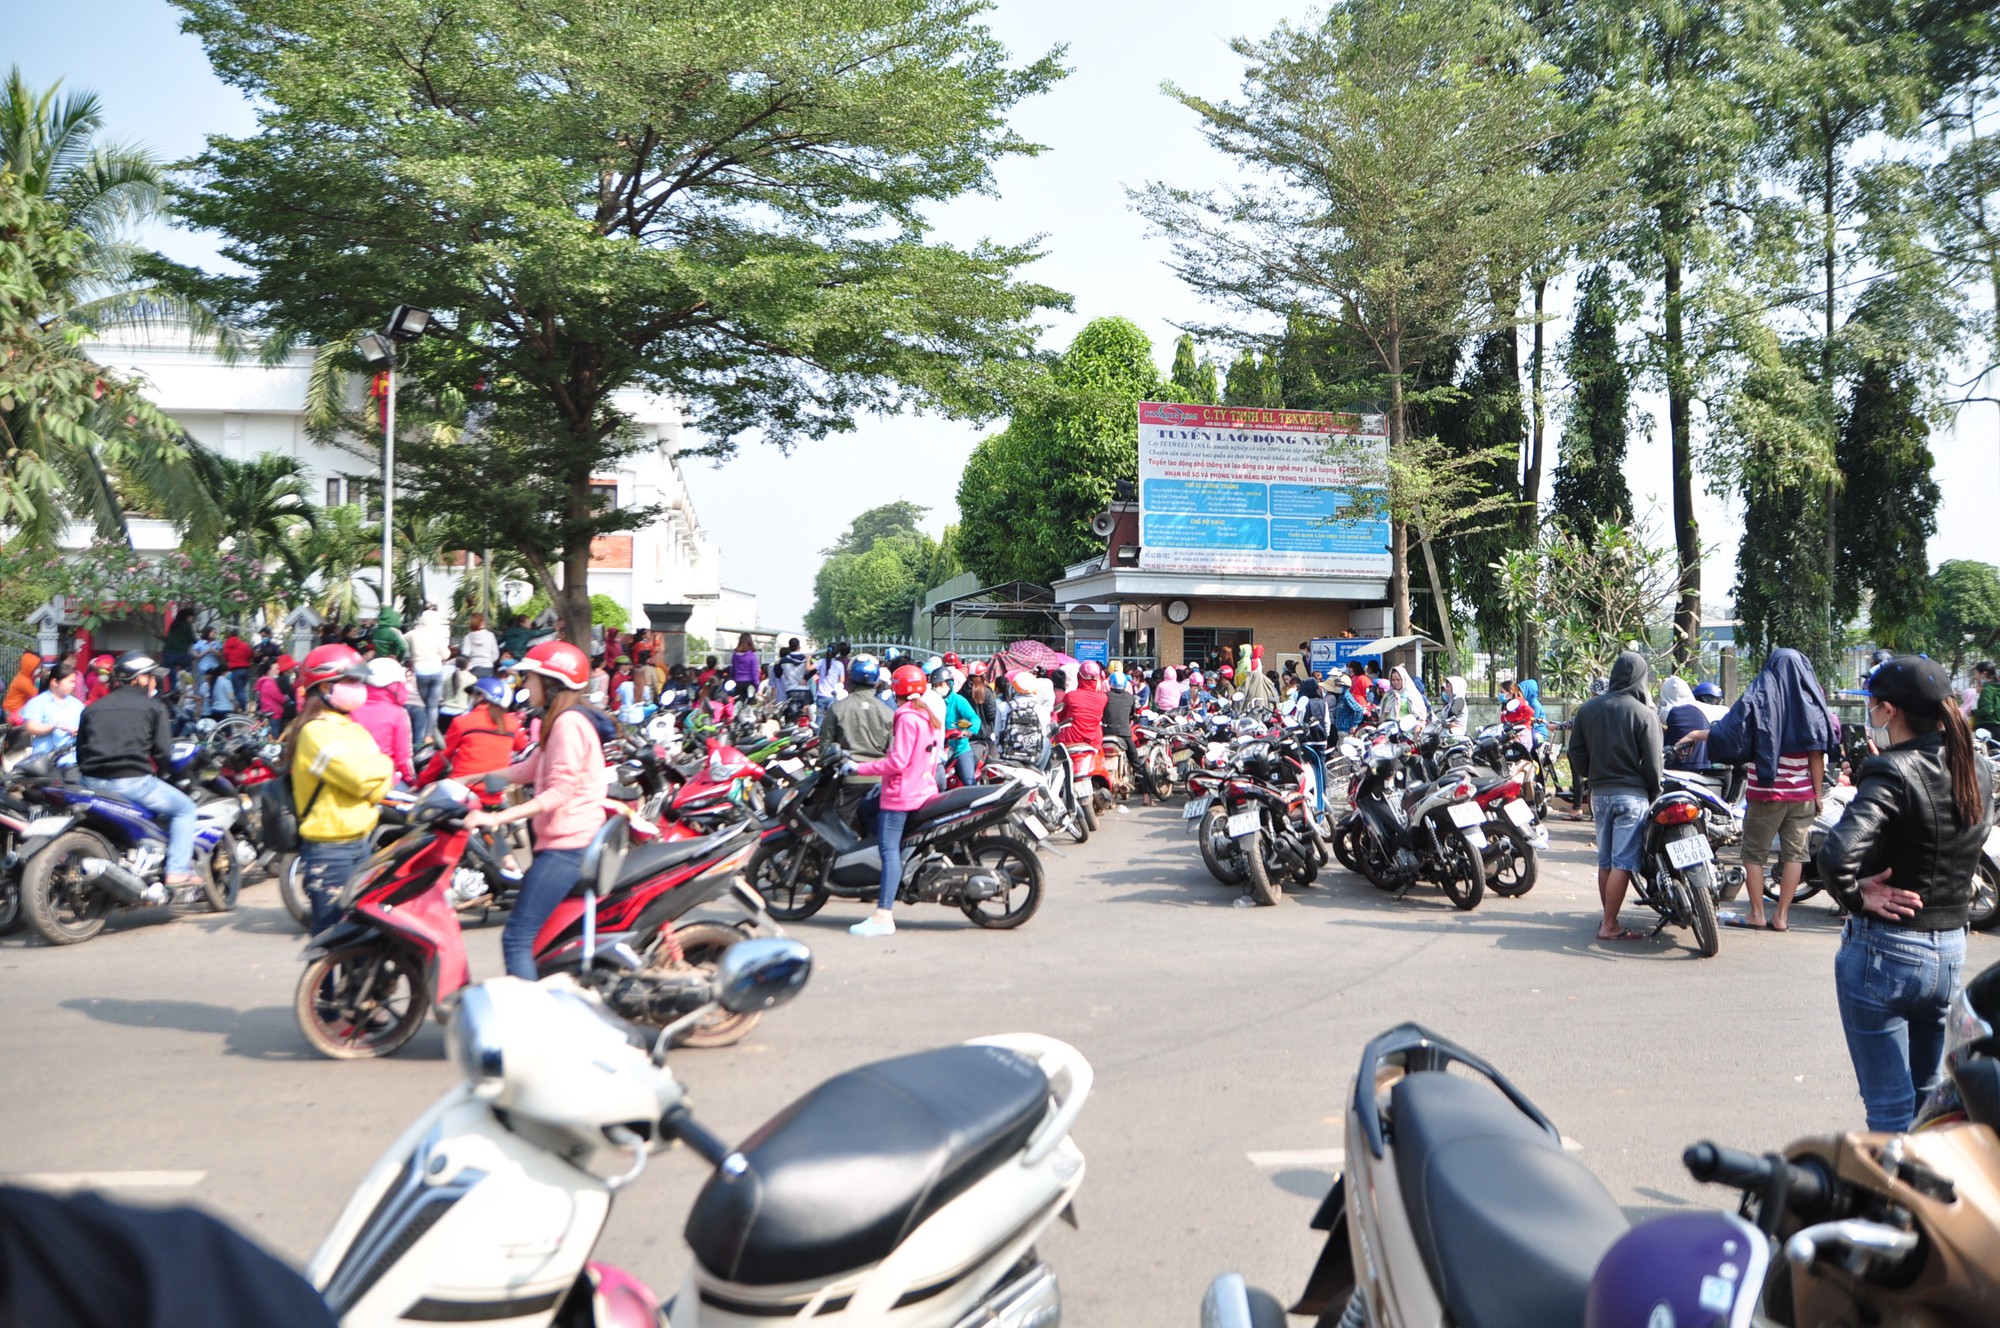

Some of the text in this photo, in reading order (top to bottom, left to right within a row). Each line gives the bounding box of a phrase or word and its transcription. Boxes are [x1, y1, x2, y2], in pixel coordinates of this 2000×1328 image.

[1203, 409, 1226, 420] C.TY
[1262, 412, 1276, 423] KL
[1216, 432, 1248, 443] LAO
[1253, 433, 1296, 445] ĐỘNG
[1148, 457, 1166, 466] Tuyển
[1178, 460, 1192, 468] động
[1206, 461, 1222, 469] thông
[1278, 474, 1297, 482] TRONG
[1672, 838, 1702, 854] 60-Z3
[1676, 849, 1706, 864] 5506
